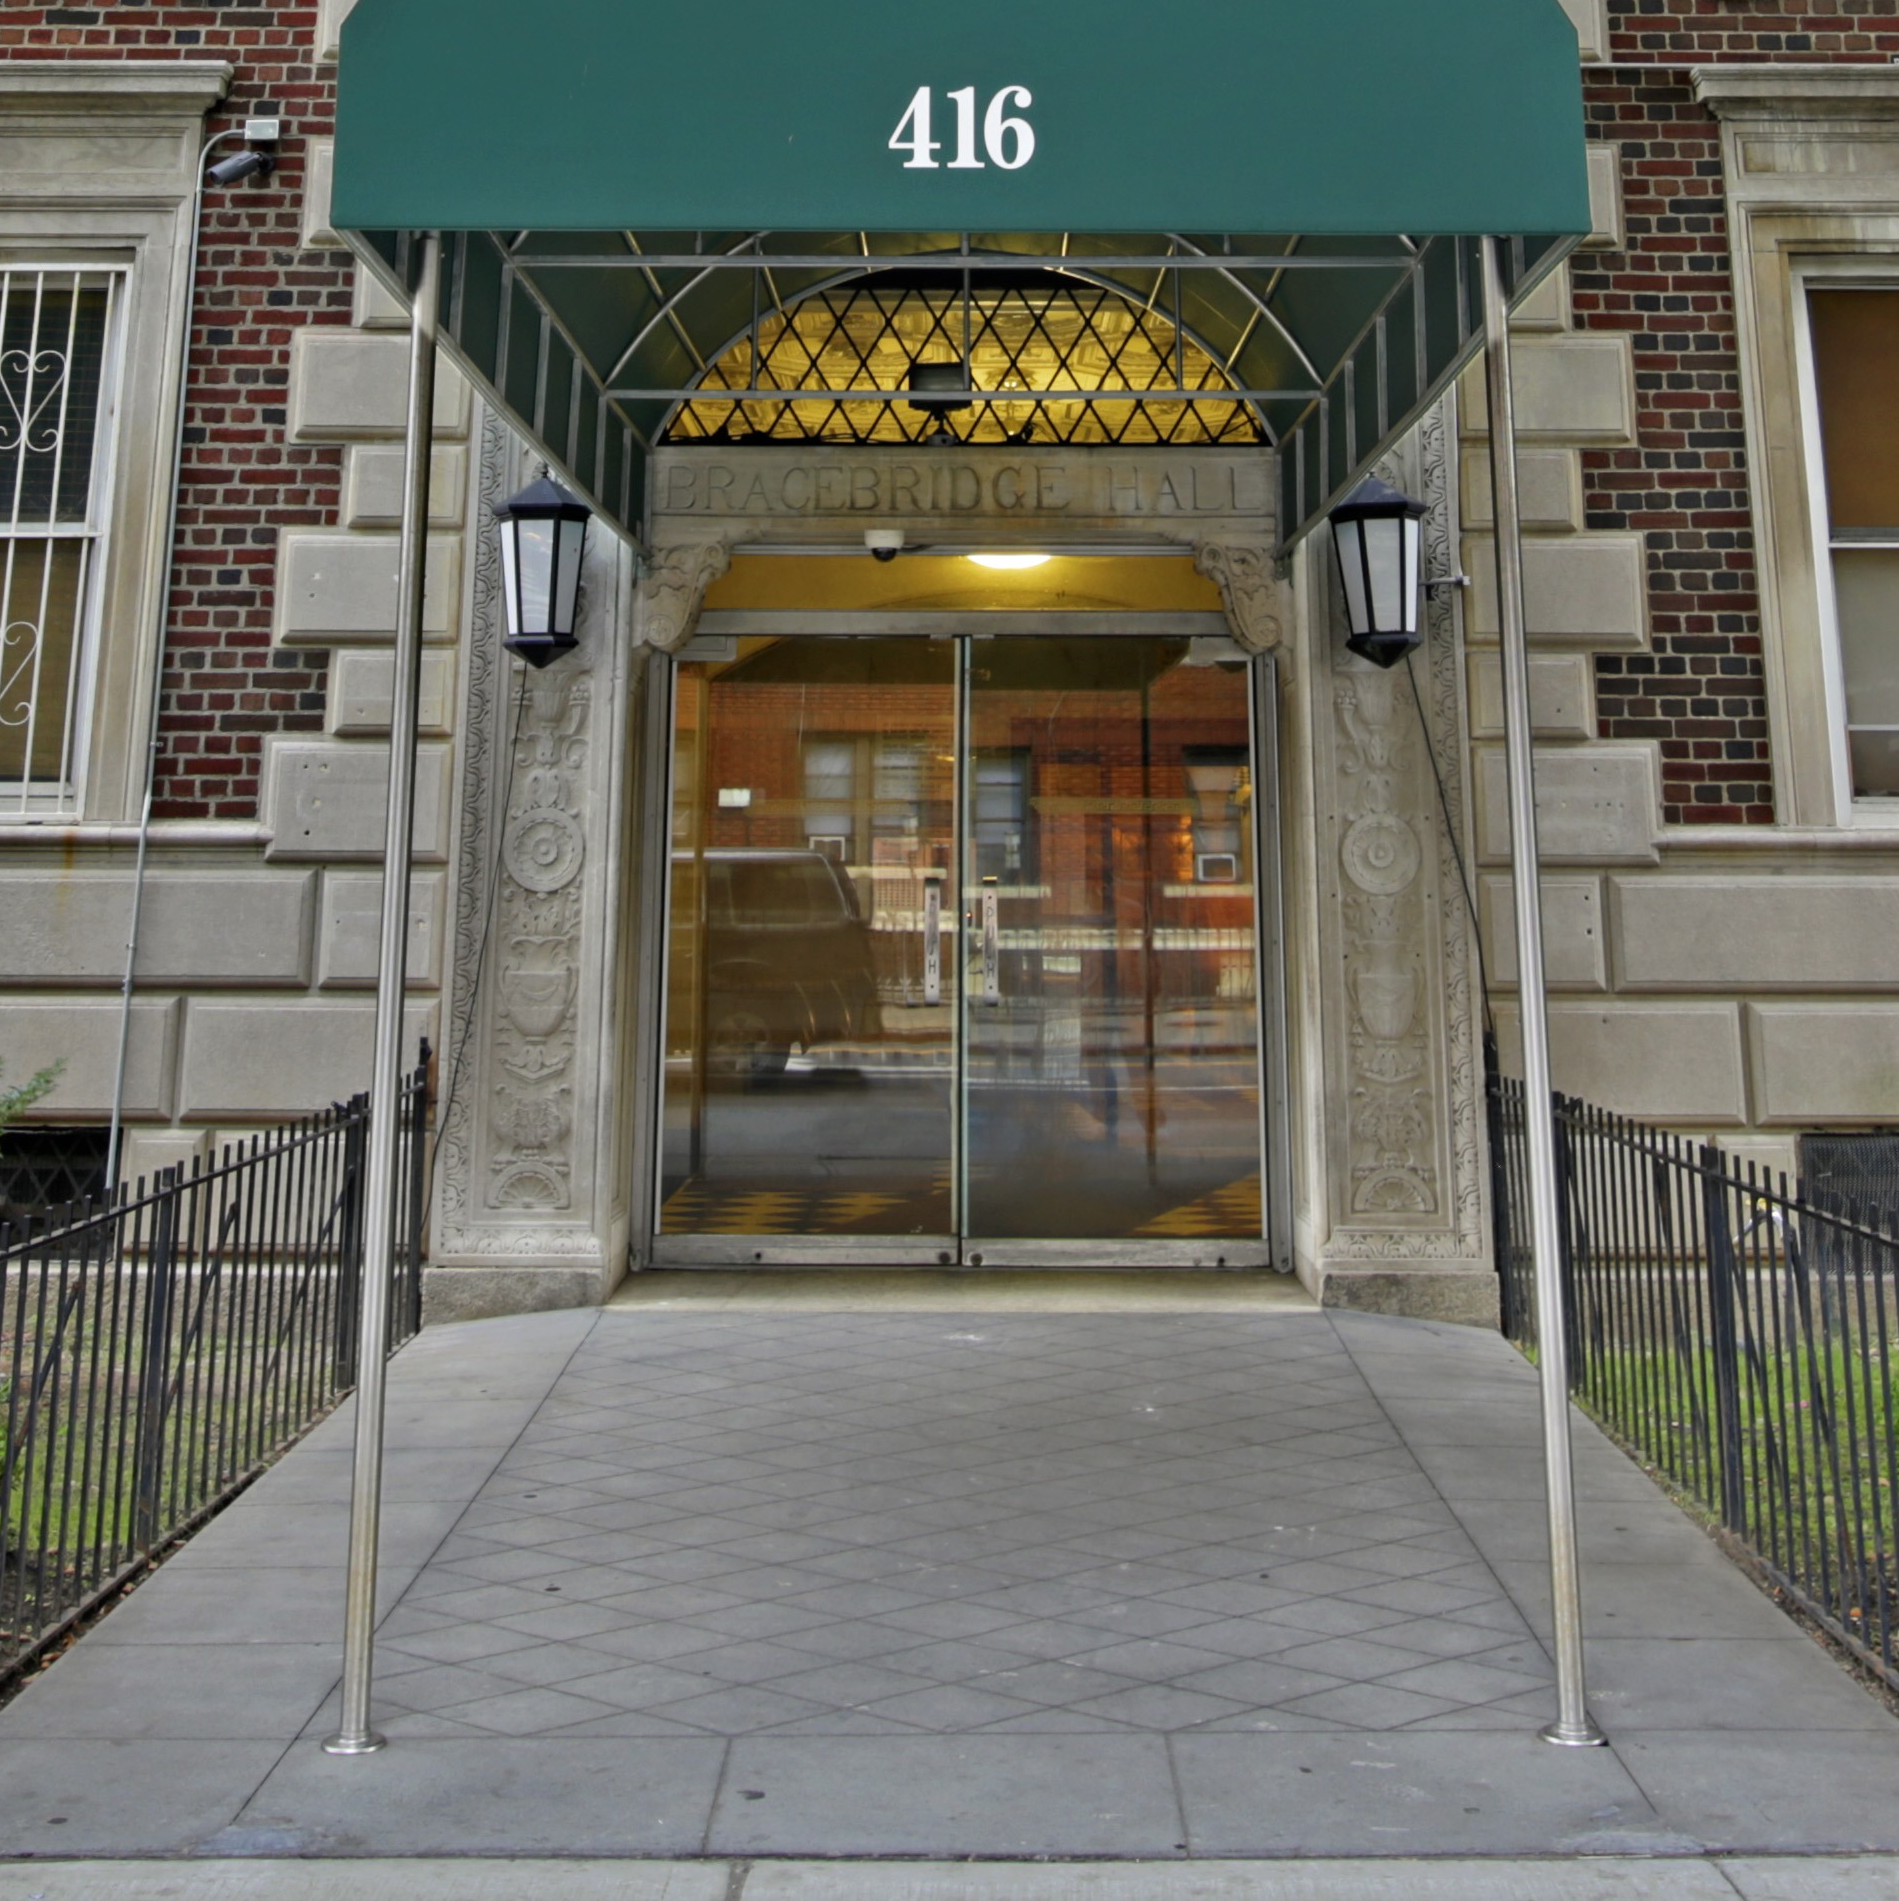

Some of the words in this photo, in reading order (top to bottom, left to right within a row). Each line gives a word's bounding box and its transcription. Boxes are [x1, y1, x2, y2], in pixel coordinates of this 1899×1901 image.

[888, 85, 1036, 170] 416
[664, 465, 1071, 512] BRACEBRIDGE
[1105, 465, 1262, 512] HALL
